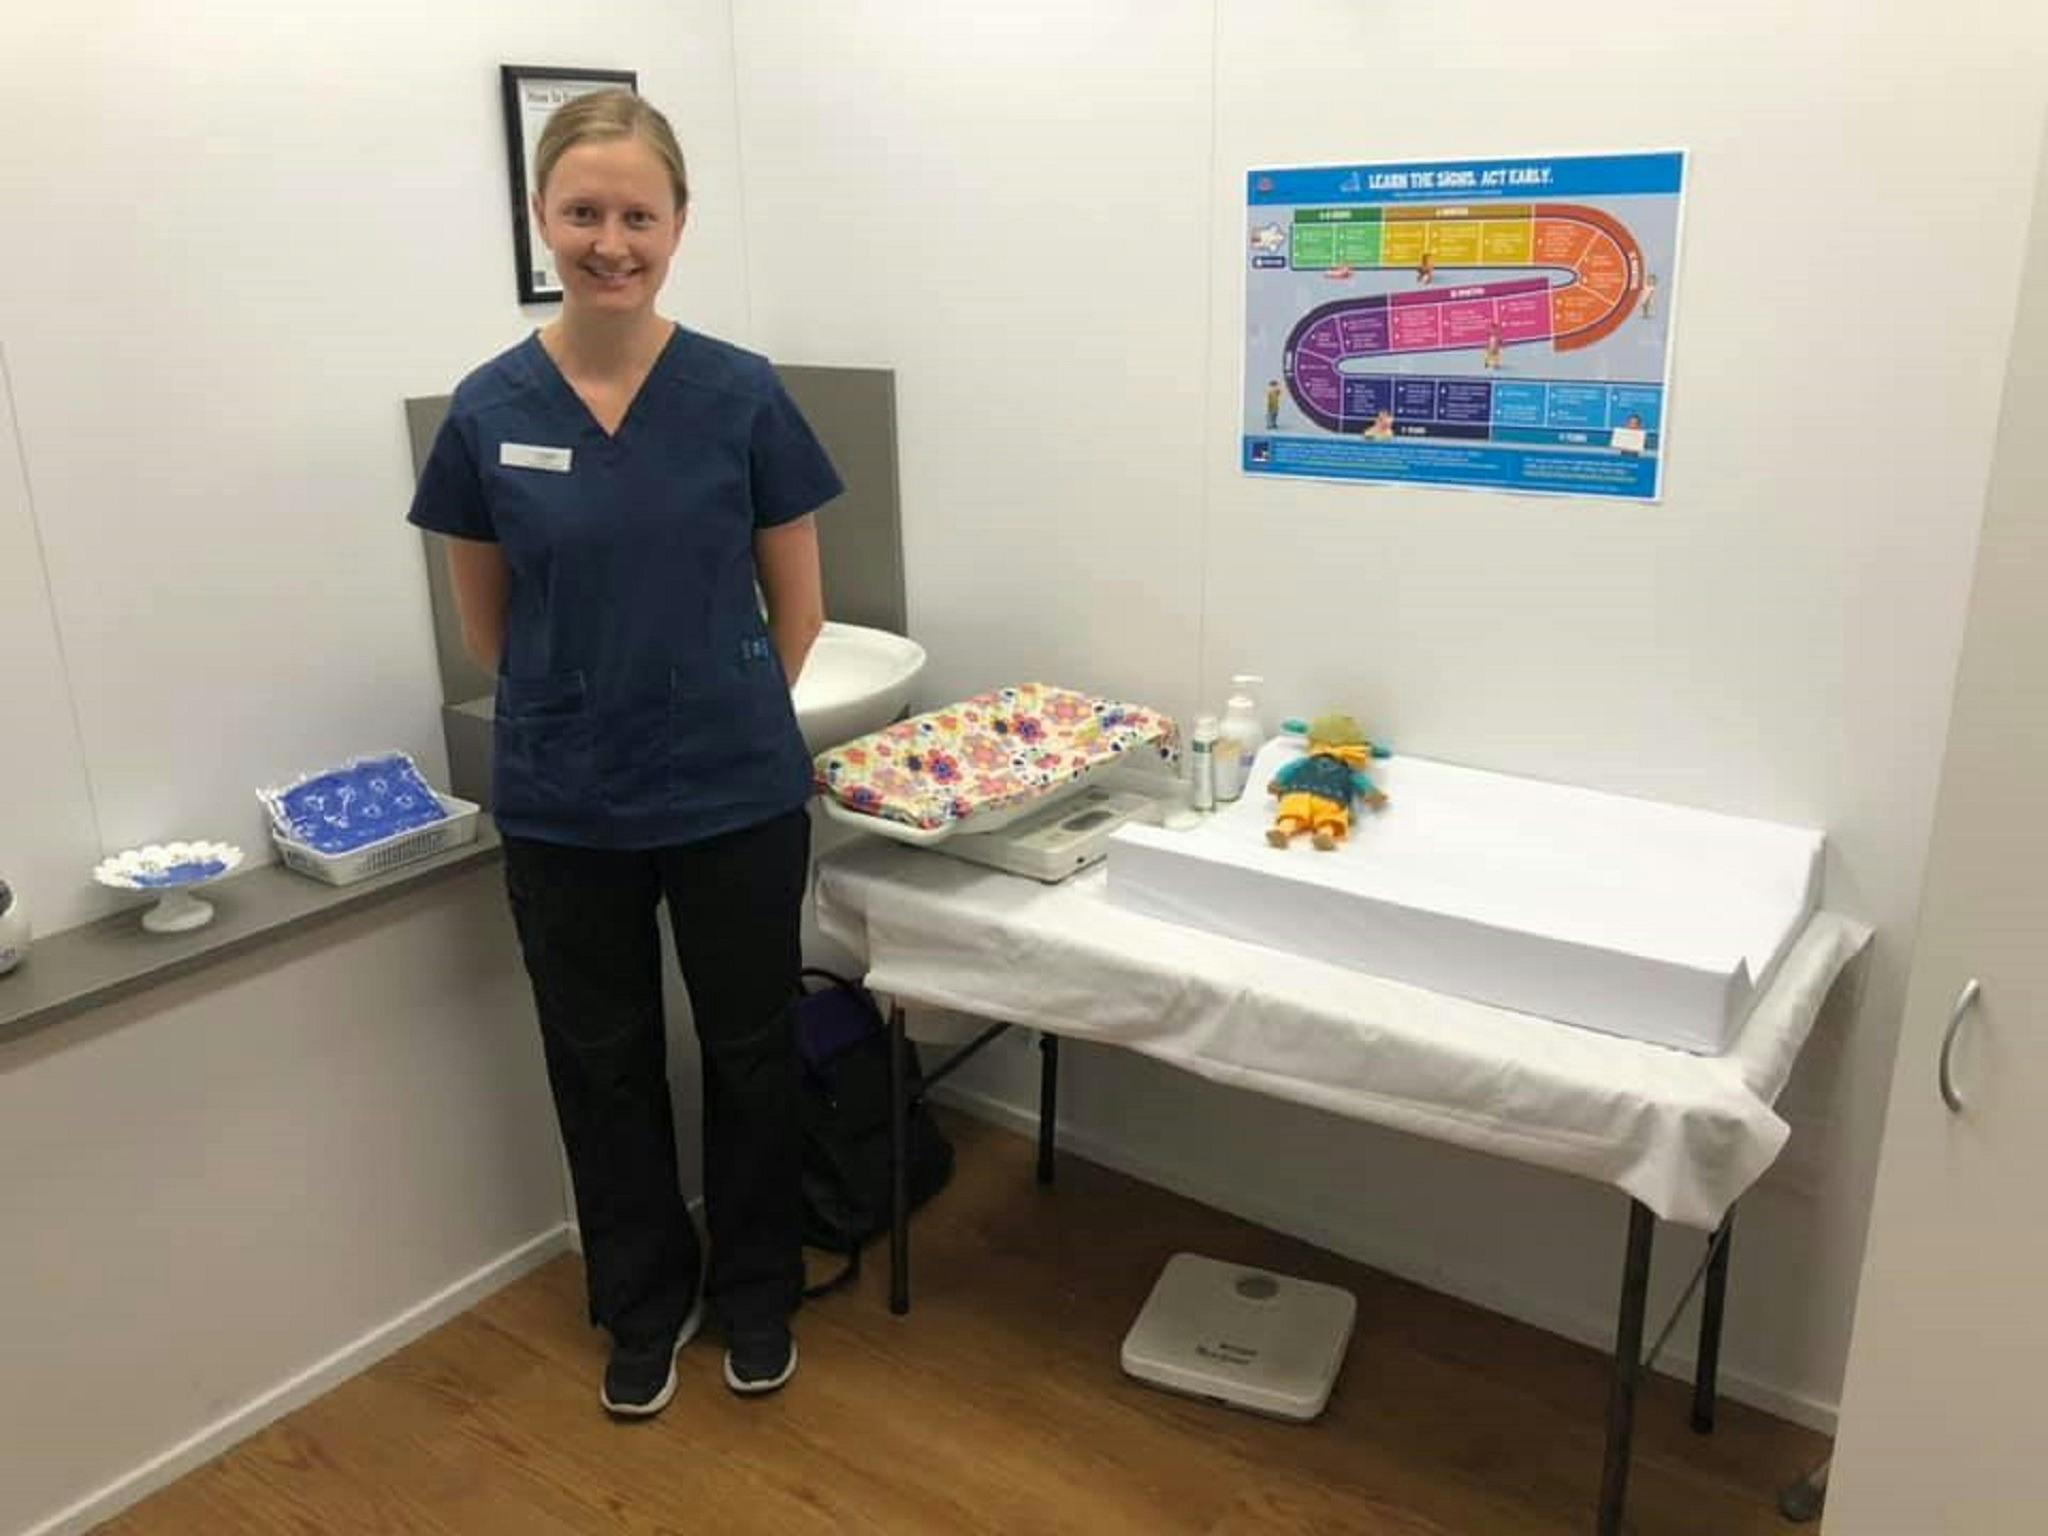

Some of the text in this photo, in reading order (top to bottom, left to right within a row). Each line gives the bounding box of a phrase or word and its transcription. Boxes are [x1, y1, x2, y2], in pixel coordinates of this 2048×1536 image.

[1369, 174, 1408, 189] LEARN
[1411, 172, 1435, 188] THE
[1481, 169, 1506, 186] ACT
[1508, 167, 1554, 184] EARLY.
